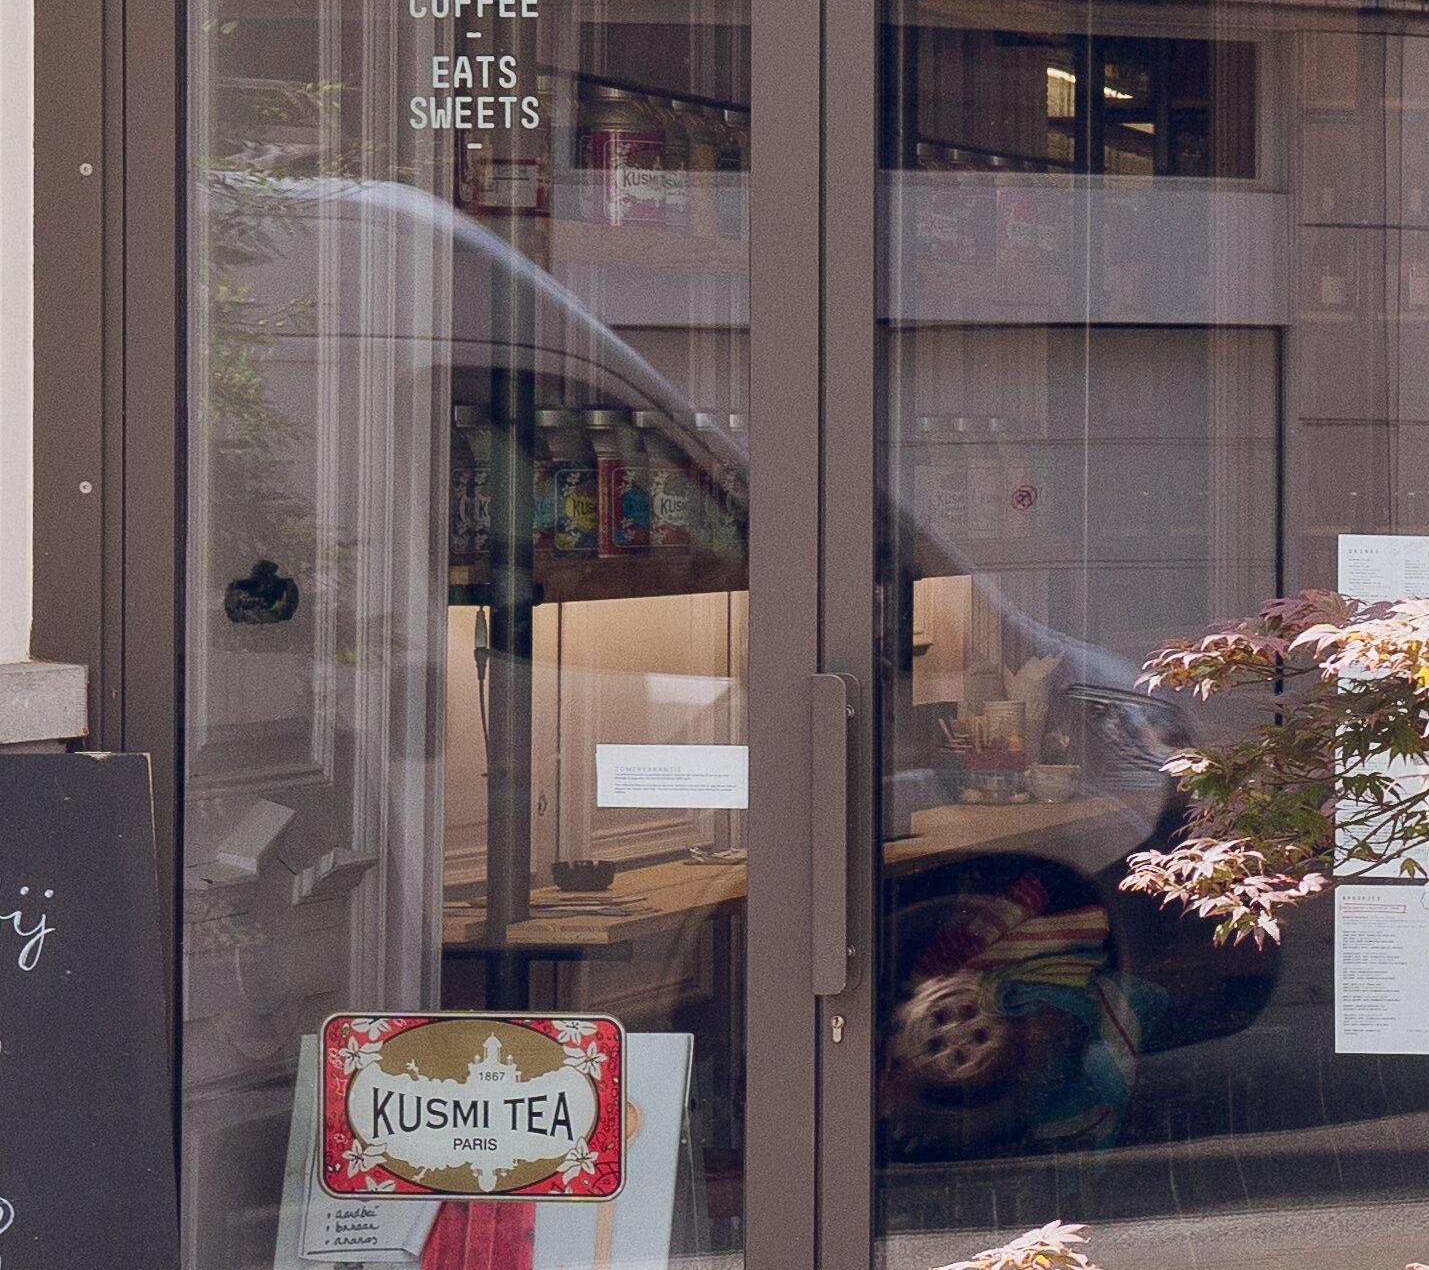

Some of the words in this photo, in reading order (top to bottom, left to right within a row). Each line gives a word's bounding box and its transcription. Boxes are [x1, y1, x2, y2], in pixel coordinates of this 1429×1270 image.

[431, 55, 518, 89] EATS
[409, 97, 540, 130] SWEETS
[478, 1070, 506, 1082] 1867
[372, 1087, 490, 1140] KUSMI
[503, 1091, 574, 1142] TEA
[453, 1138, 498, 1152] PARIS
